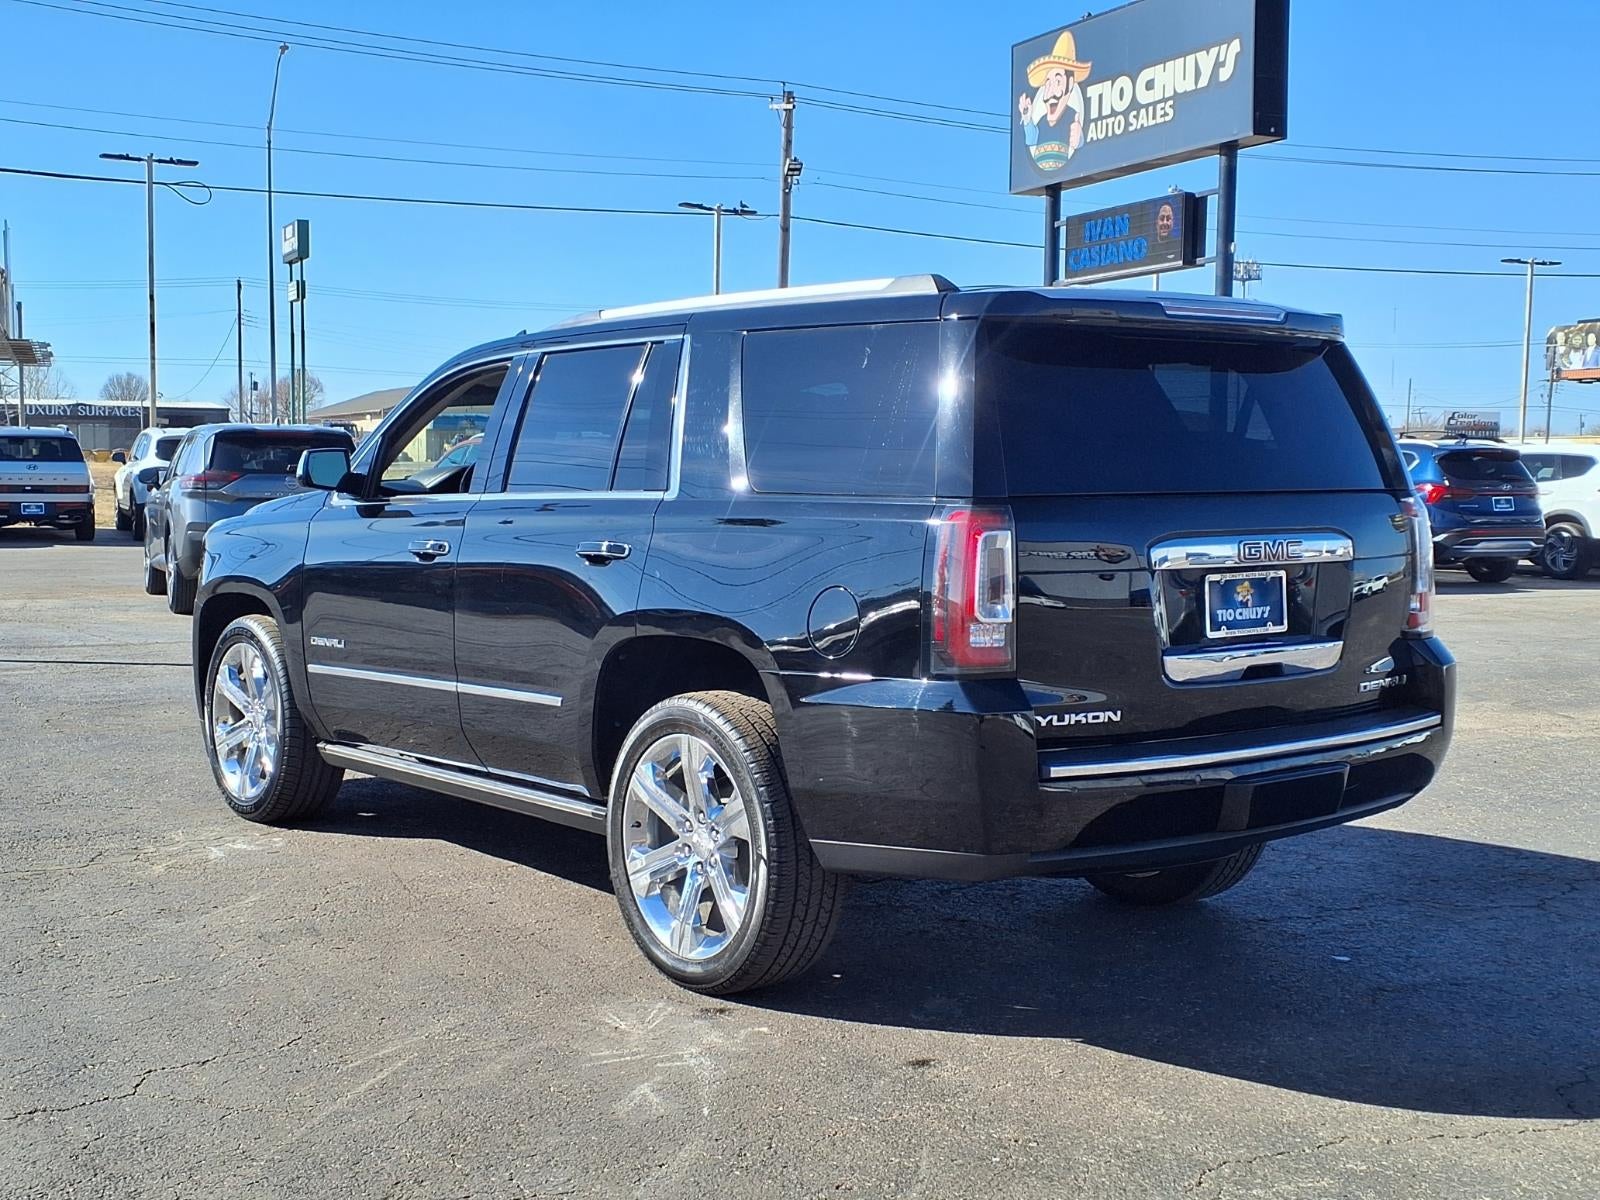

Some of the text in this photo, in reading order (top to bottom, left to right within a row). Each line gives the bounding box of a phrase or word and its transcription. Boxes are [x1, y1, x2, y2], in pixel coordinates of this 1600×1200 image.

[1086, 38, 1241, 120] TIO CHUY'S
[1086, 100, 1174, 143] AUTO SALES
[1084, 213, 1130, 244] IVAN
[24, 404, 143, 417] UXURY SURFACES
[1451, 411, 1478, 420] Color
[1447, 417, 1498, 427] Creations
[1238, 538, 1304, 564] GMC
[1217, 605, 1271, 622] TIO CHUY'S
[1034, 710, 1122, 727] YUKON
